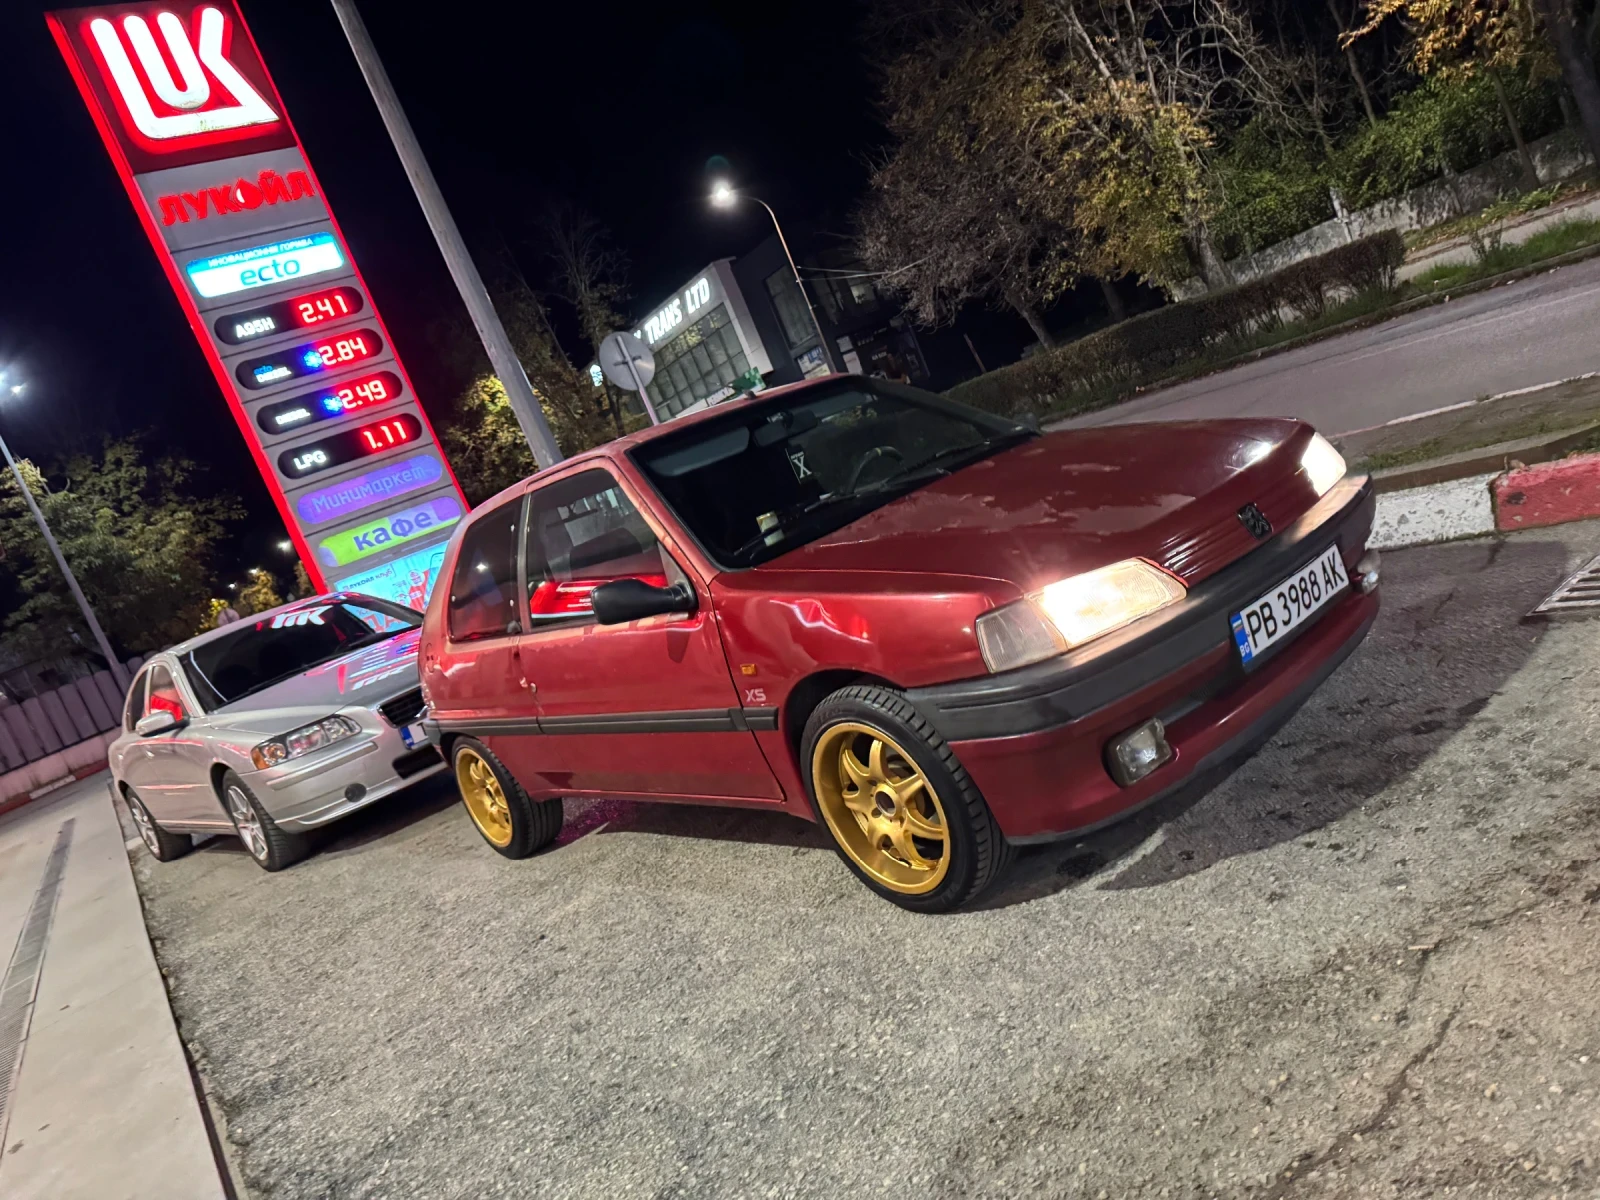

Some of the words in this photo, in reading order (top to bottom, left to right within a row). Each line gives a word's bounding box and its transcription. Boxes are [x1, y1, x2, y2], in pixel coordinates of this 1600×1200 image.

[157, 169, 315, 227] ЛУКОЙЛ
[240, 259, 300, 286] ecto
[298, 294, 349, 323] 2.41
[644, 298, 683, 345] TRANS
[684, 277, 711, 314] LTD
[318, 337, 368, 366] 2.84
[338, 379, 388, 409] 2.49
[293, 450, 327, 470] LPG
[363, 421, 407, 449] 1.11
[312, 466, 425, 514] Минимаркет
[353, 511, 433, 551] кафе
[1246, 601, 1278, 648] PB
[1277, 569, 1322, 627] 3988
[1321, 551, 1345, 595] AK
[1240, 642, 1250, 657] BG
[745, 688, 767, 702] XS
